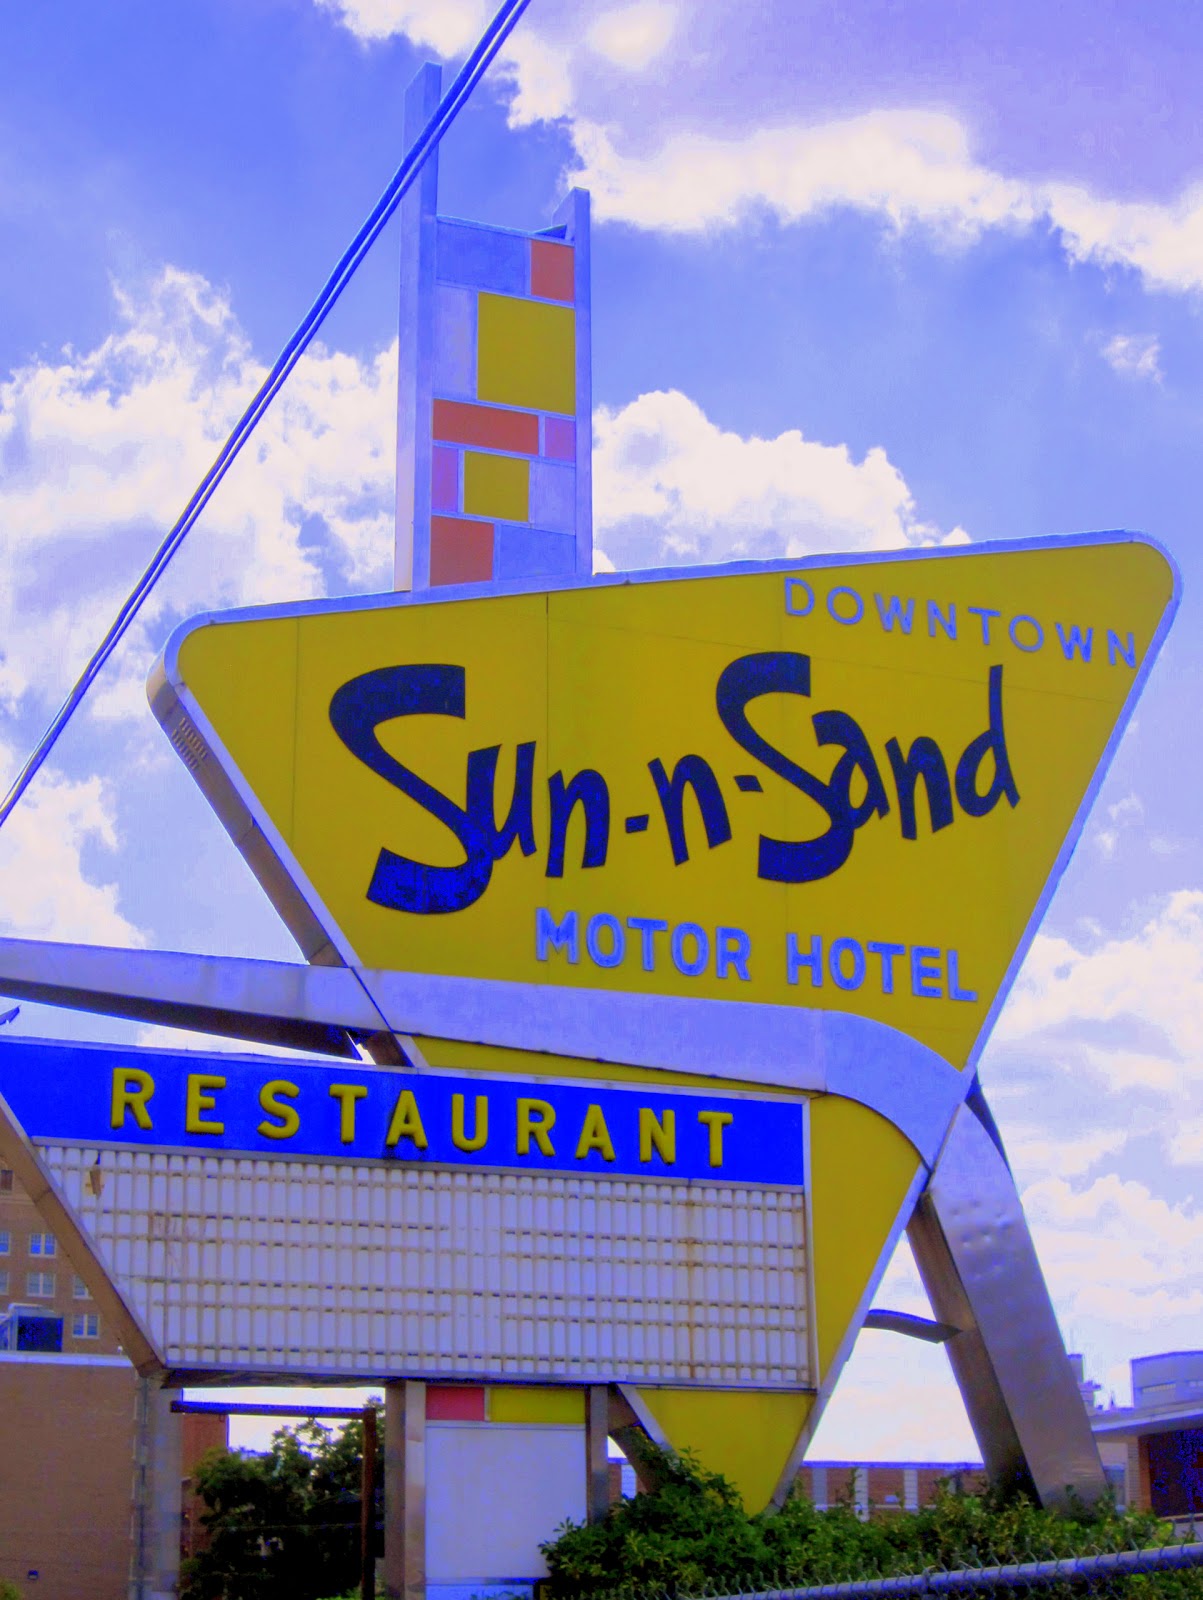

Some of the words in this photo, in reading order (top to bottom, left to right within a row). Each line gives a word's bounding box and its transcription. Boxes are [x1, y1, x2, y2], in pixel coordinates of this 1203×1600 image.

[784, 577, 1138, 669] DOWNTOWN
[328, 652, 1021, 915] Sun-n-Sand
[535, 906, 752, 982] MOTOR
[786, 932, 979, 1002] HOTEL
[110, 1067, 735, 1168] RESTAURANT
